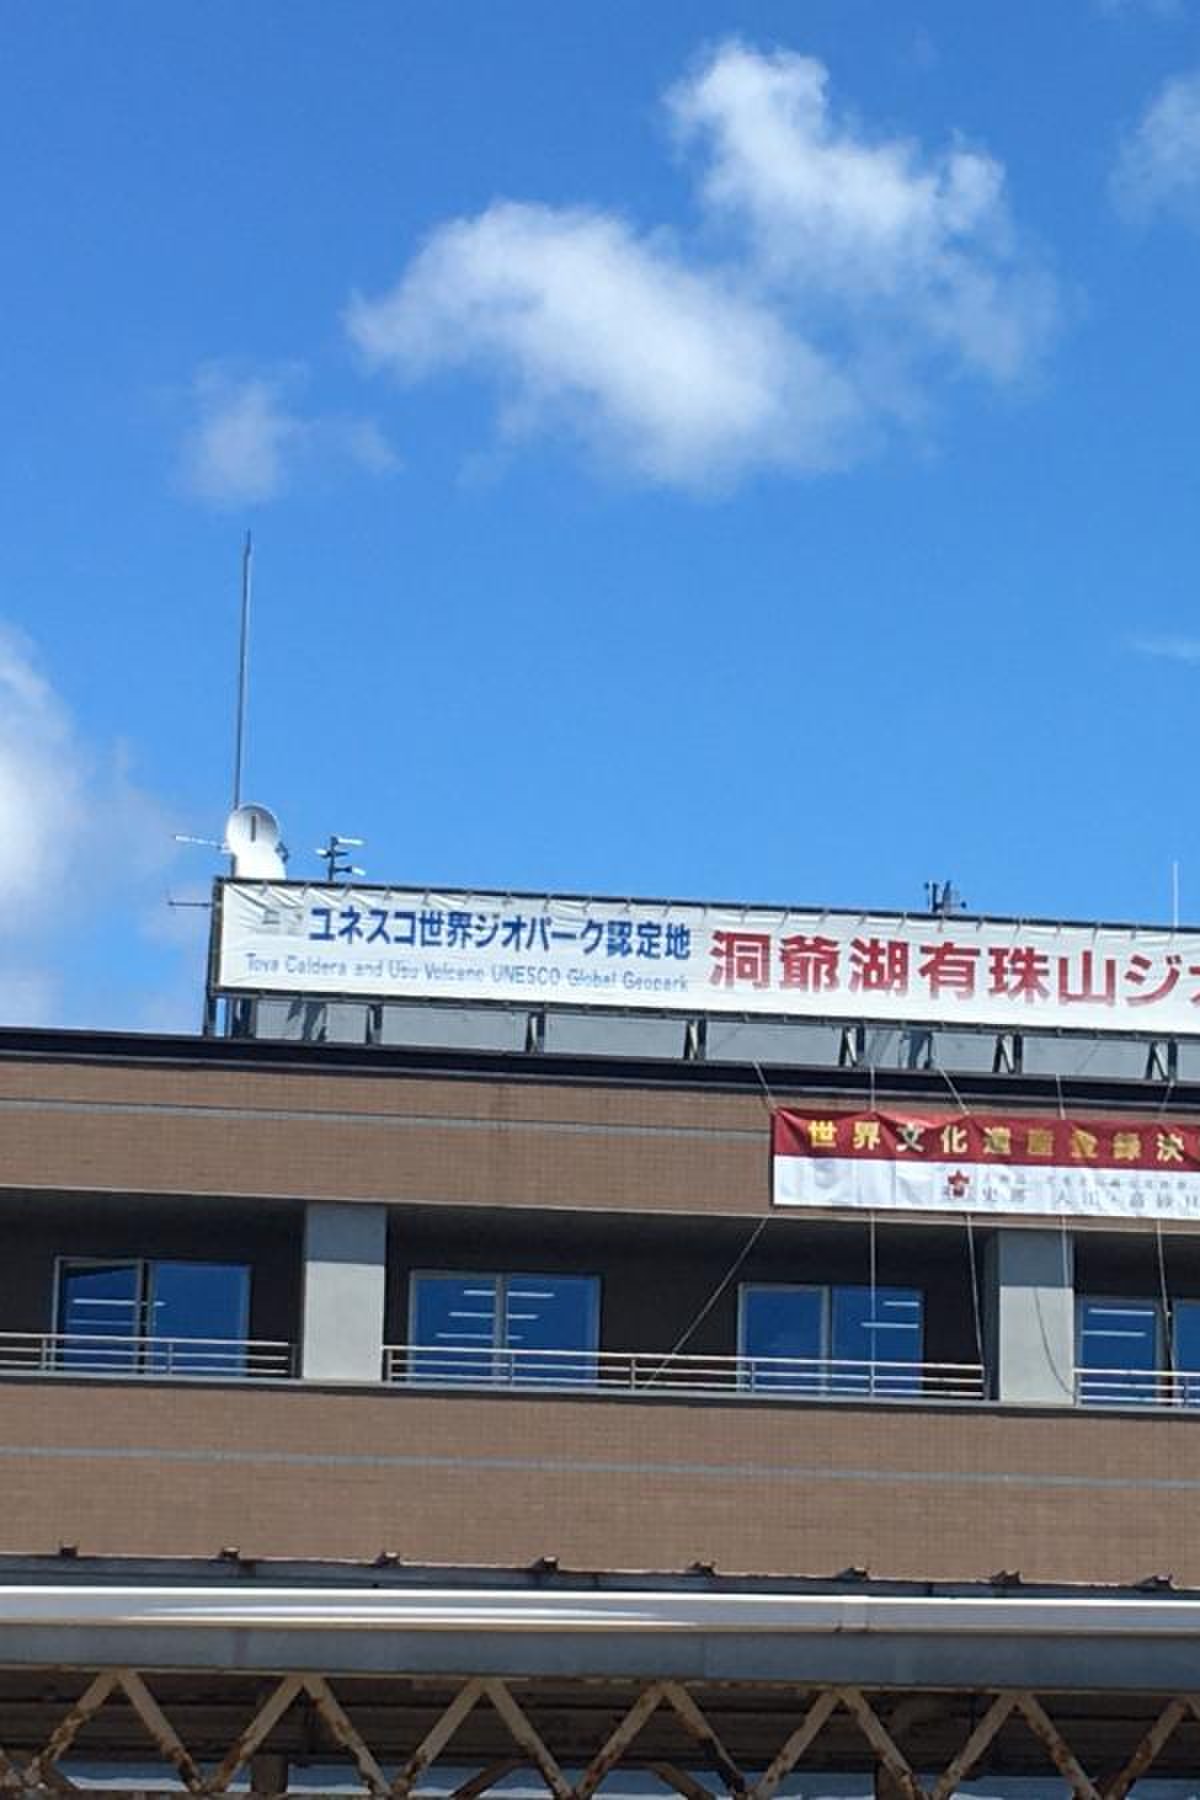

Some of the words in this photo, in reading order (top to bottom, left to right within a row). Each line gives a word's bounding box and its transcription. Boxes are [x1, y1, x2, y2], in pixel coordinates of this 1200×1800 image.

[309, 905, 692, 960] ユネスコ世界ジオパーク認定地
[285, 954, 348, 977] Caldera
[354, 960, 383, 978] and
[425, 962, 485, 981] Volcano
[491, 964, 561, 986] UNESCO
[566, 968, 617, 988] Global
[623, 971, 689, 992] Geopark
